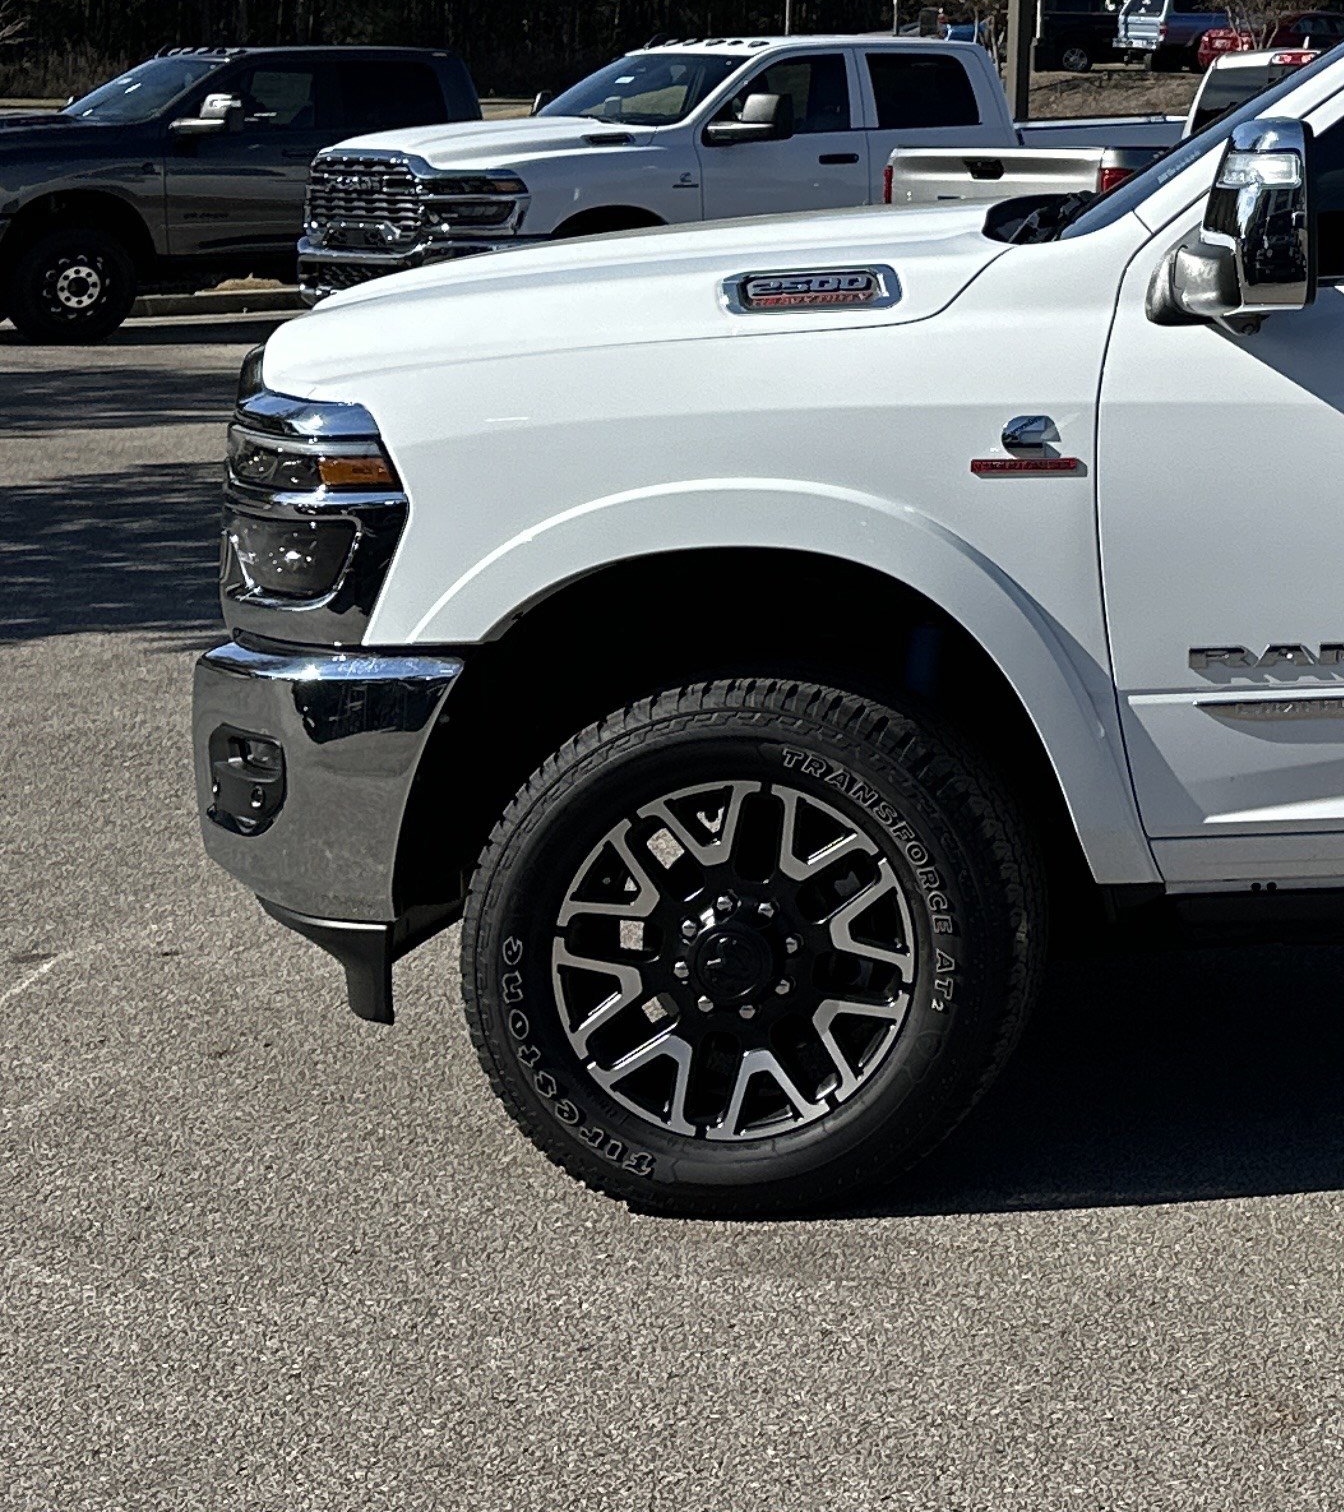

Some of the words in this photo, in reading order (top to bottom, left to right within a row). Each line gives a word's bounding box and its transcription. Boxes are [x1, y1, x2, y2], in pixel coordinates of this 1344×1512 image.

[751, 277, 871, 297] 2500
[782, 748, 953, 935] TRANSFORCE
[502, 936, 657, 1176] Firestone
